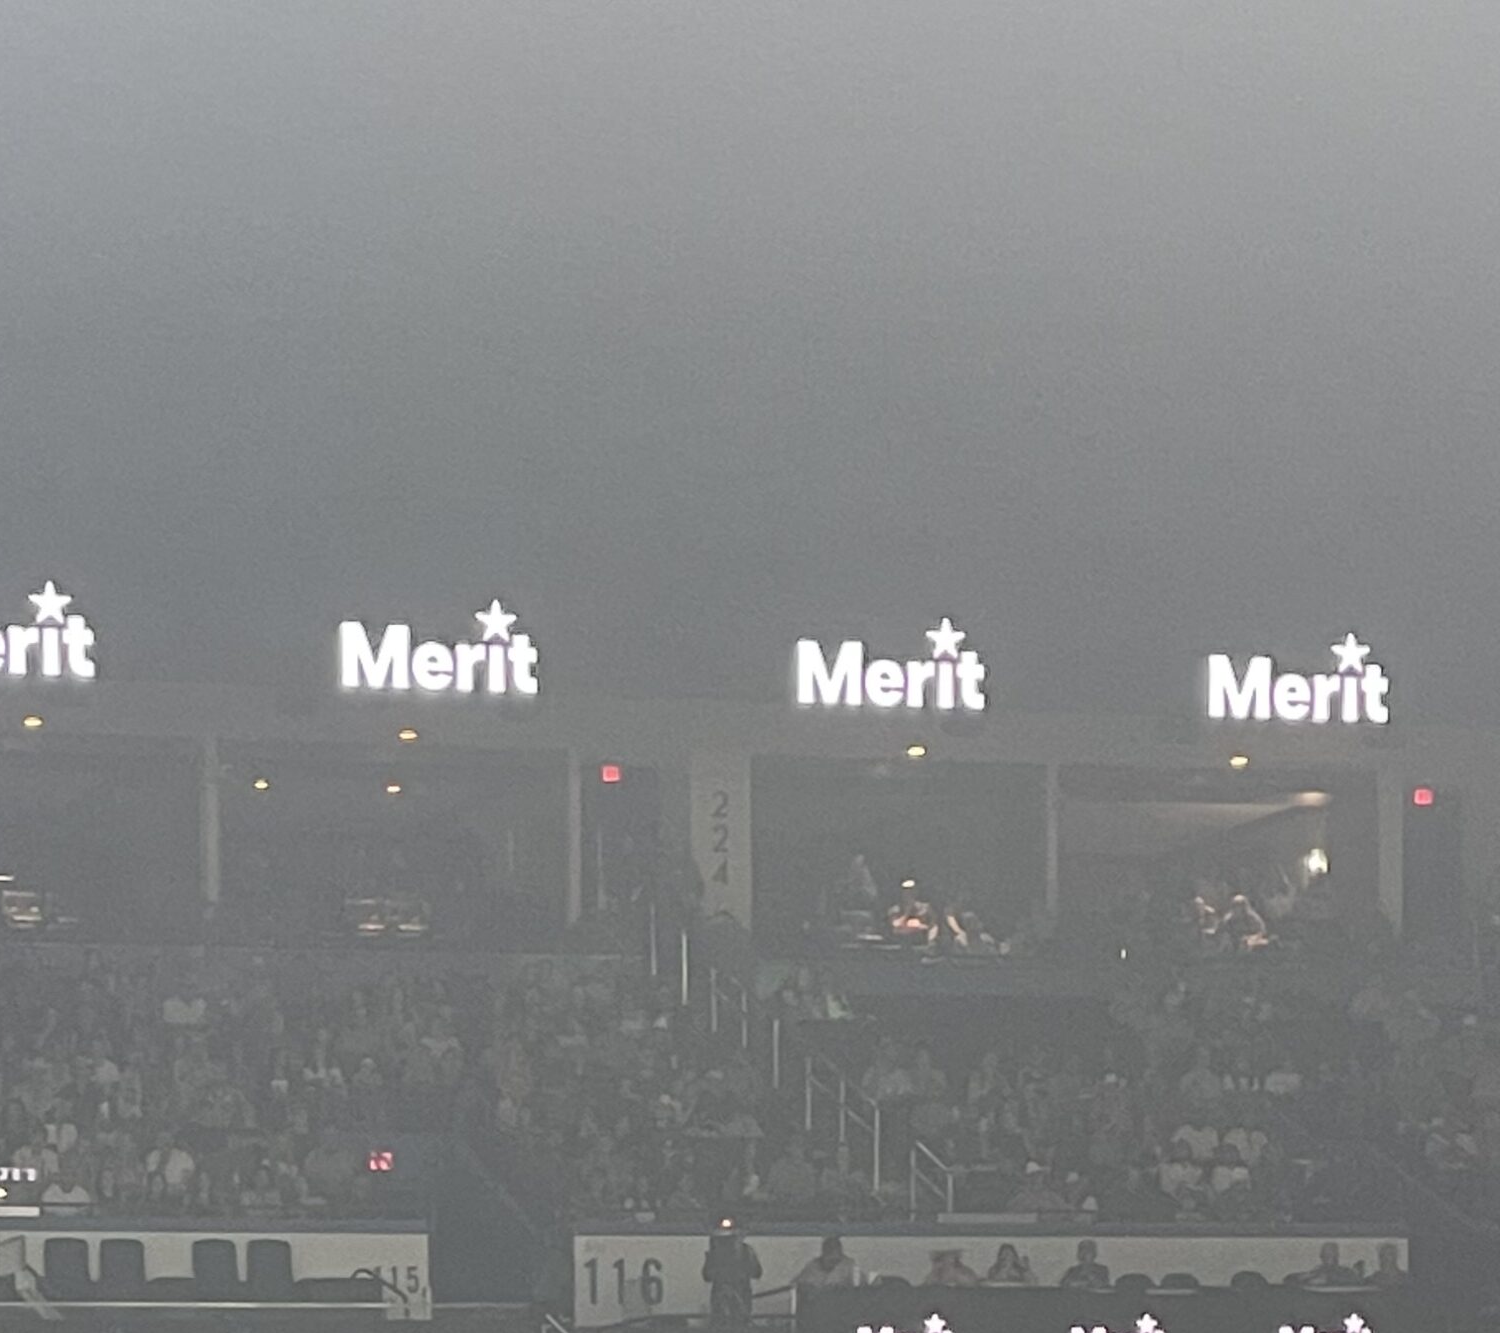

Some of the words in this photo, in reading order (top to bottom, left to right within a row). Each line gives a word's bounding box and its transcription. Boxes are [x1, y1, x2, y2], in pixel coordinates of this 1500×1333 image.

[340, 600, 537, 694] Merit
[797, 618, 984, 710] Merit
[1209, 633, 1388, 723] Merit
[584, 1257, 663, 1306] 116
